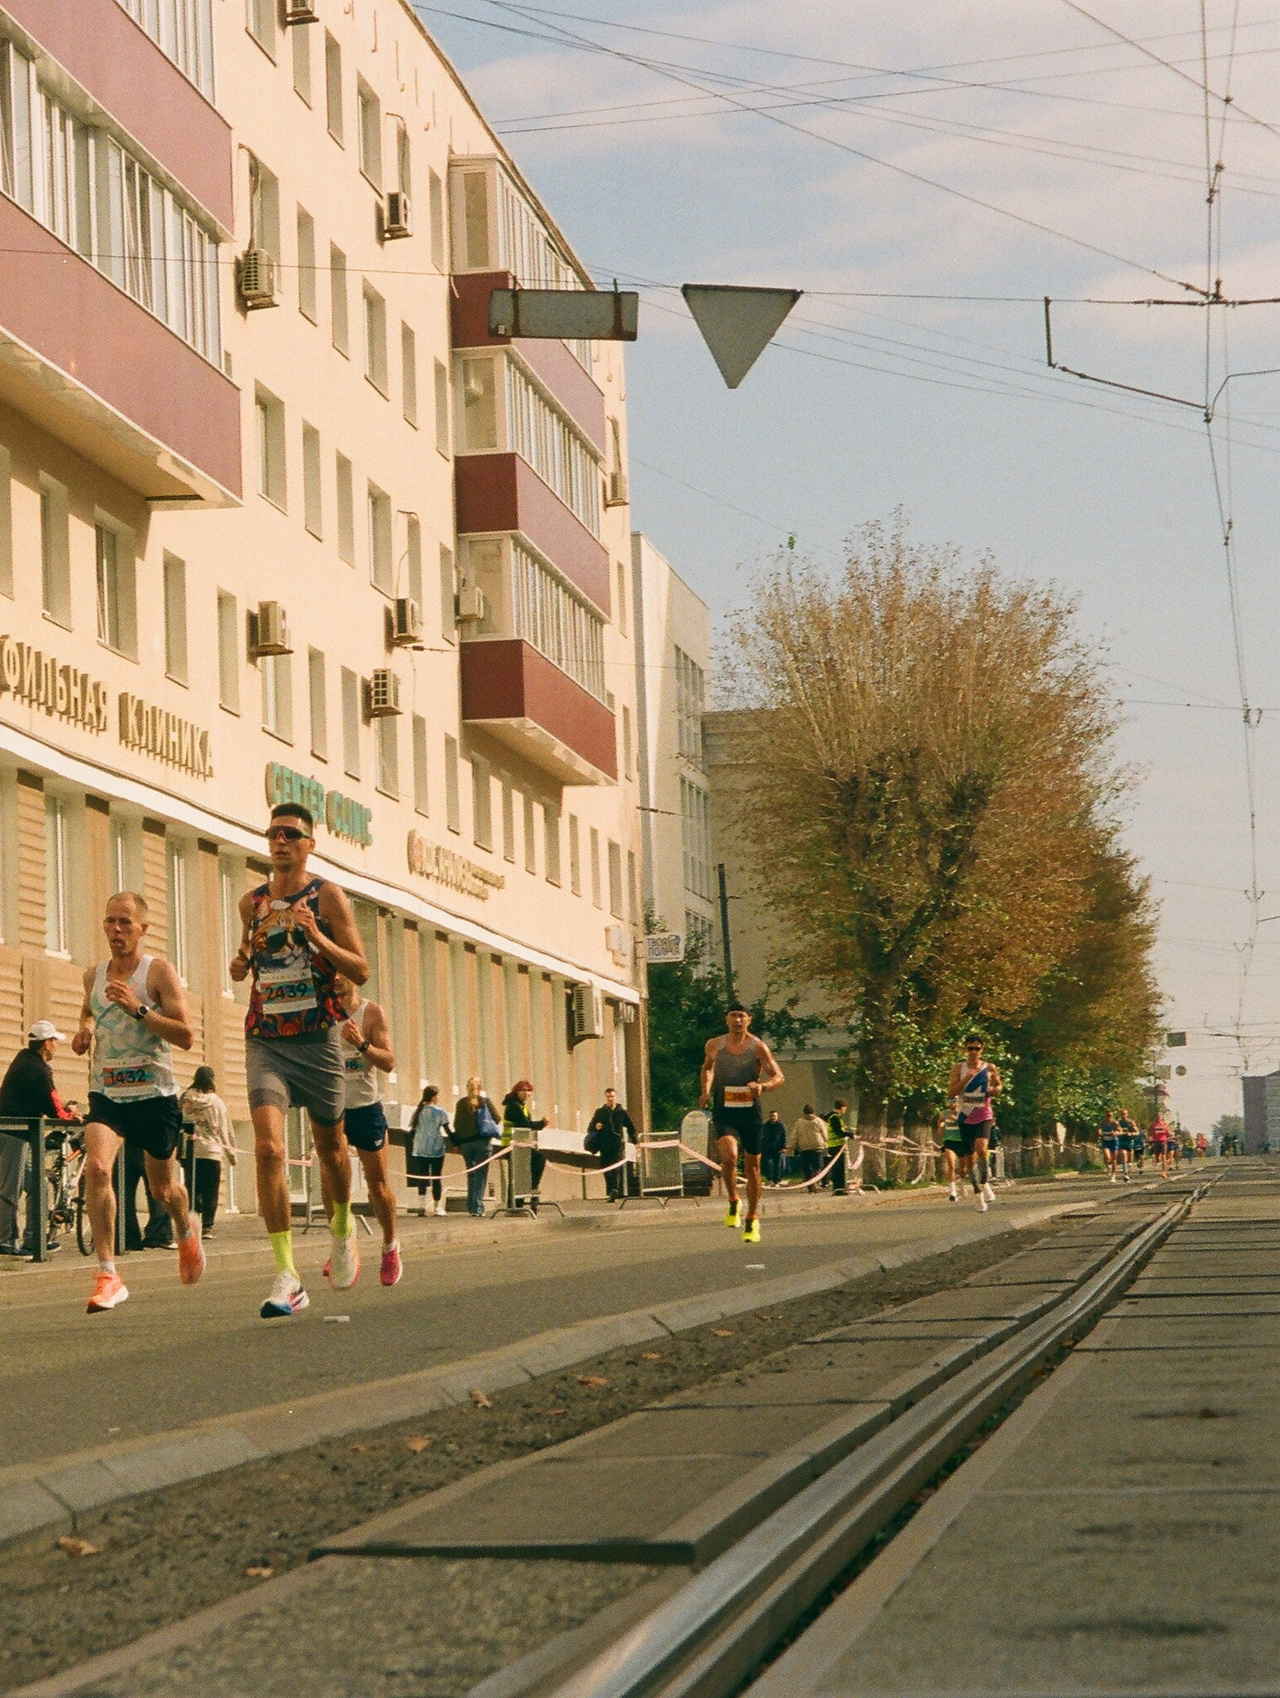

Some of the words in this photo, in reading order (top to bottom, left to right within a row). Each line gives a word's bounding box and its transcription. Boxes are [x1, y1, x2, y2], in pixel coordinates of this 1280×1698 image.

[119, 692, 214, 778] КЛИНИКА
[265, 984, 308, 1001] 2439
[110, 1069, 146, 1085] 1432
